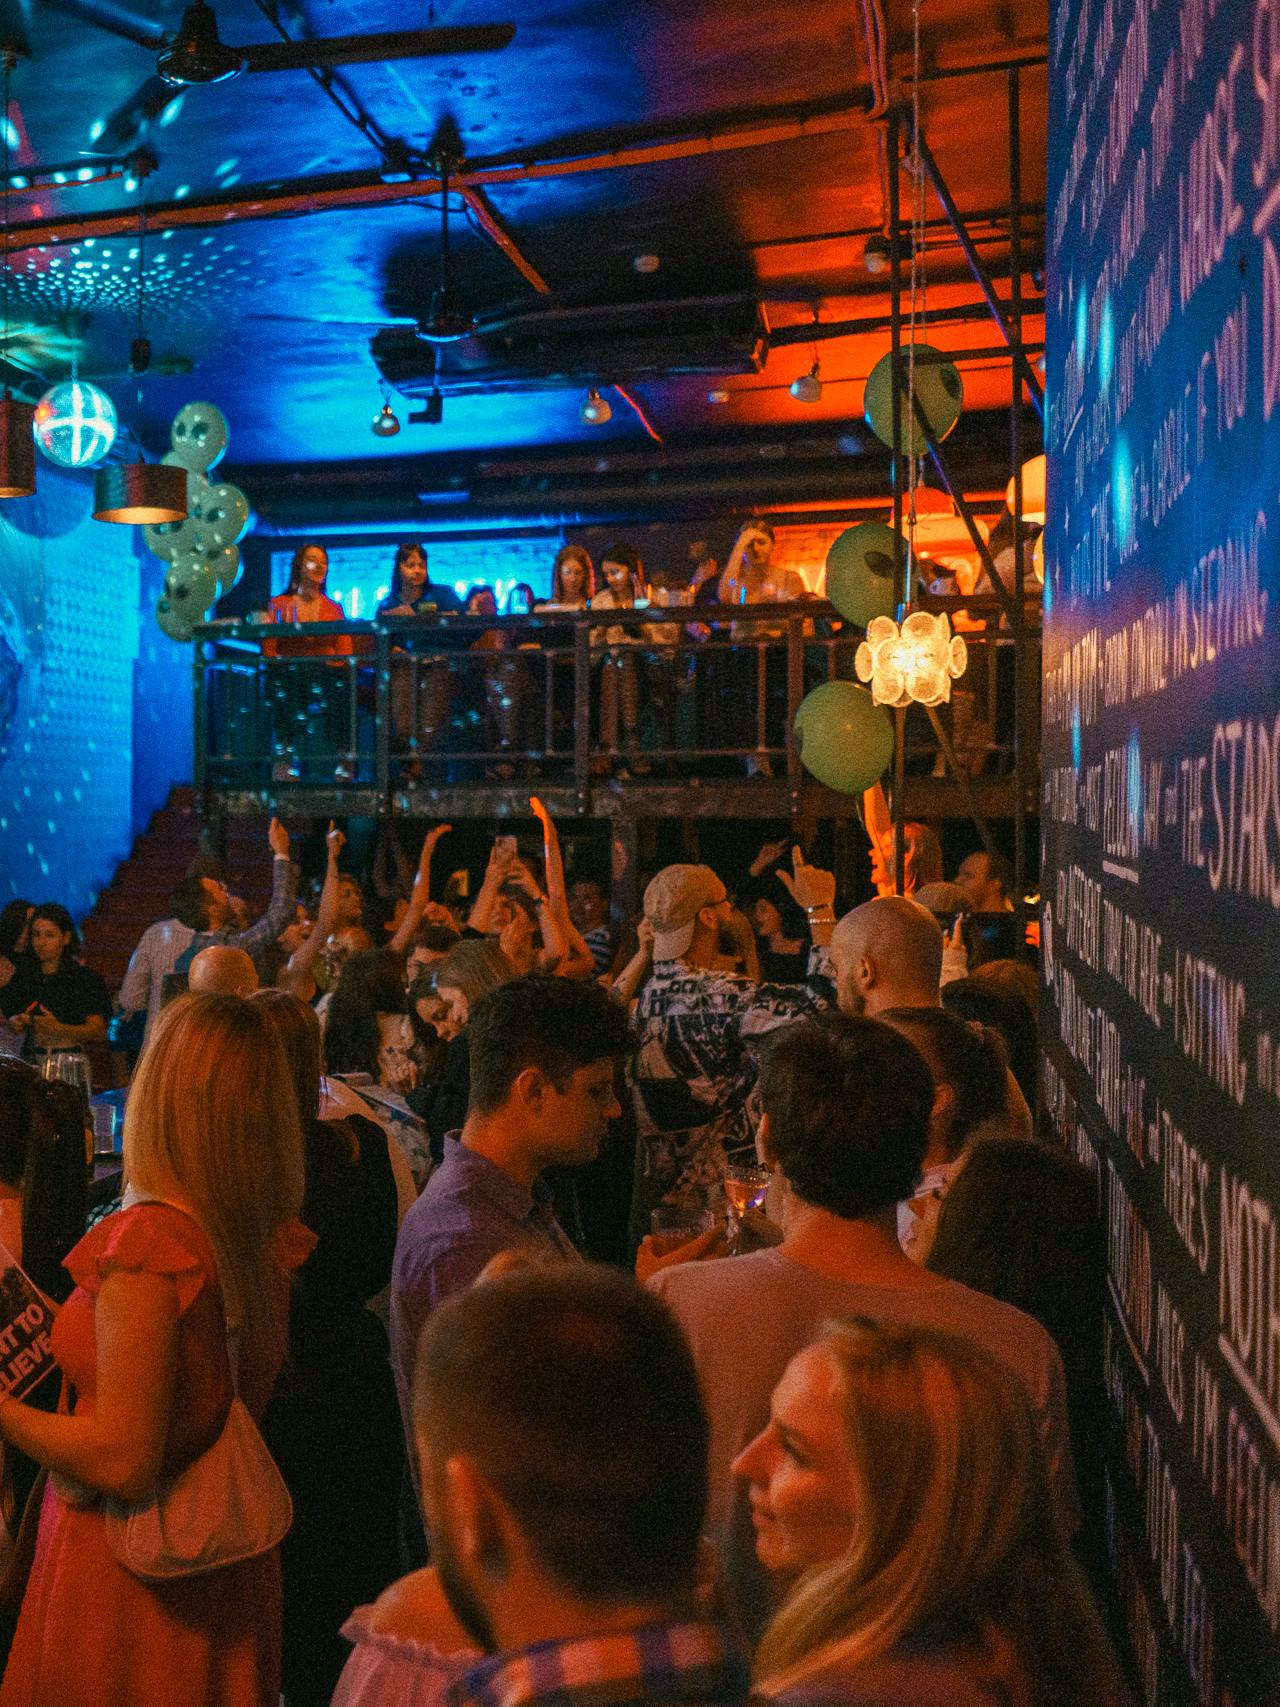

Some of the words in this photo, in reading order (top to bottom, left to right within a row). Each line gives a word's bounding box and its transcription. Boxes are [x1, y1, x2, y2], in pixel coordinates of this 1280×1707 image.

[1189, 507, 1268, 666] STEPPING
[1103, 749, 1139, 861] PECULIAR
[1181, 758, 1206, 871] THE
[1182, 955, 1245, 1107] SITTING
[1163, 1111, 1209, 1276] THERE'S
[13, 1304, 44, 1334] TO
